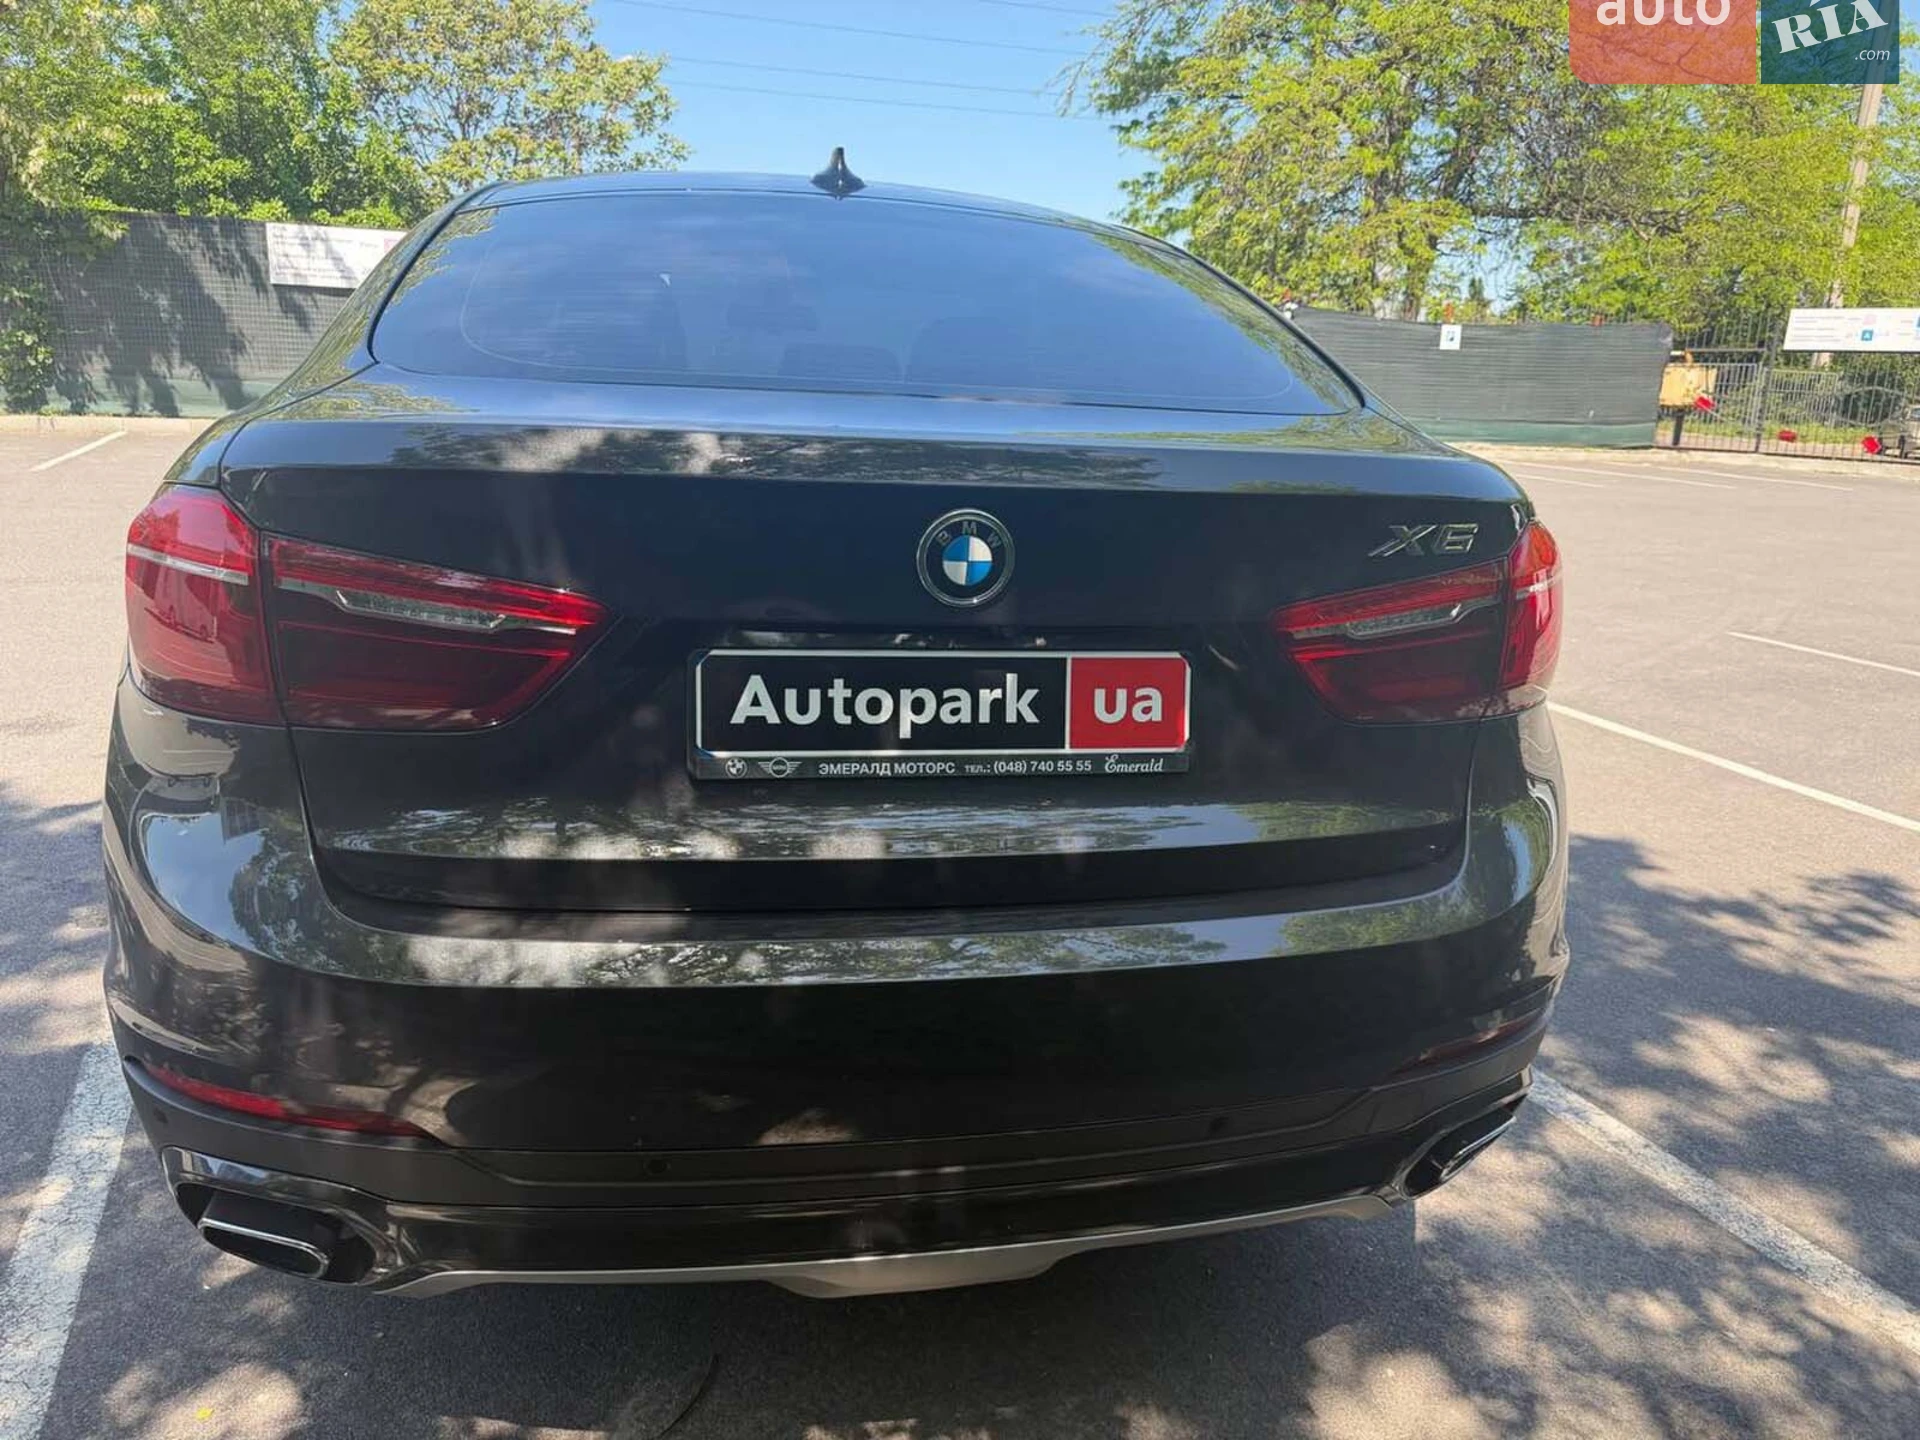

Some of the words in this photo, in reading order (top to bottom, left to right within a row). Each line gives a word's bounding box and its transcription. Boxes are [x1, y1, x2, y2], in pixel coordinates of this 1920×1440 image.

[1367, 523, 1479, 557] X6
[730, 673, 1040, 739] Autopark
[1093, 686, 1163, 724] ua
[818, 762, 892, 776] ЭМЕРАЛД
[894, 761, 956, 775] МОТОРС
[993, 759, 1027, 775] (048)
[1030, 760, 1055, 773] 740
[1057, 760, 1073, 773] 55
[1076, 759, 1092, 772] 55
[1104, 753, 1164, 773] Emerald
